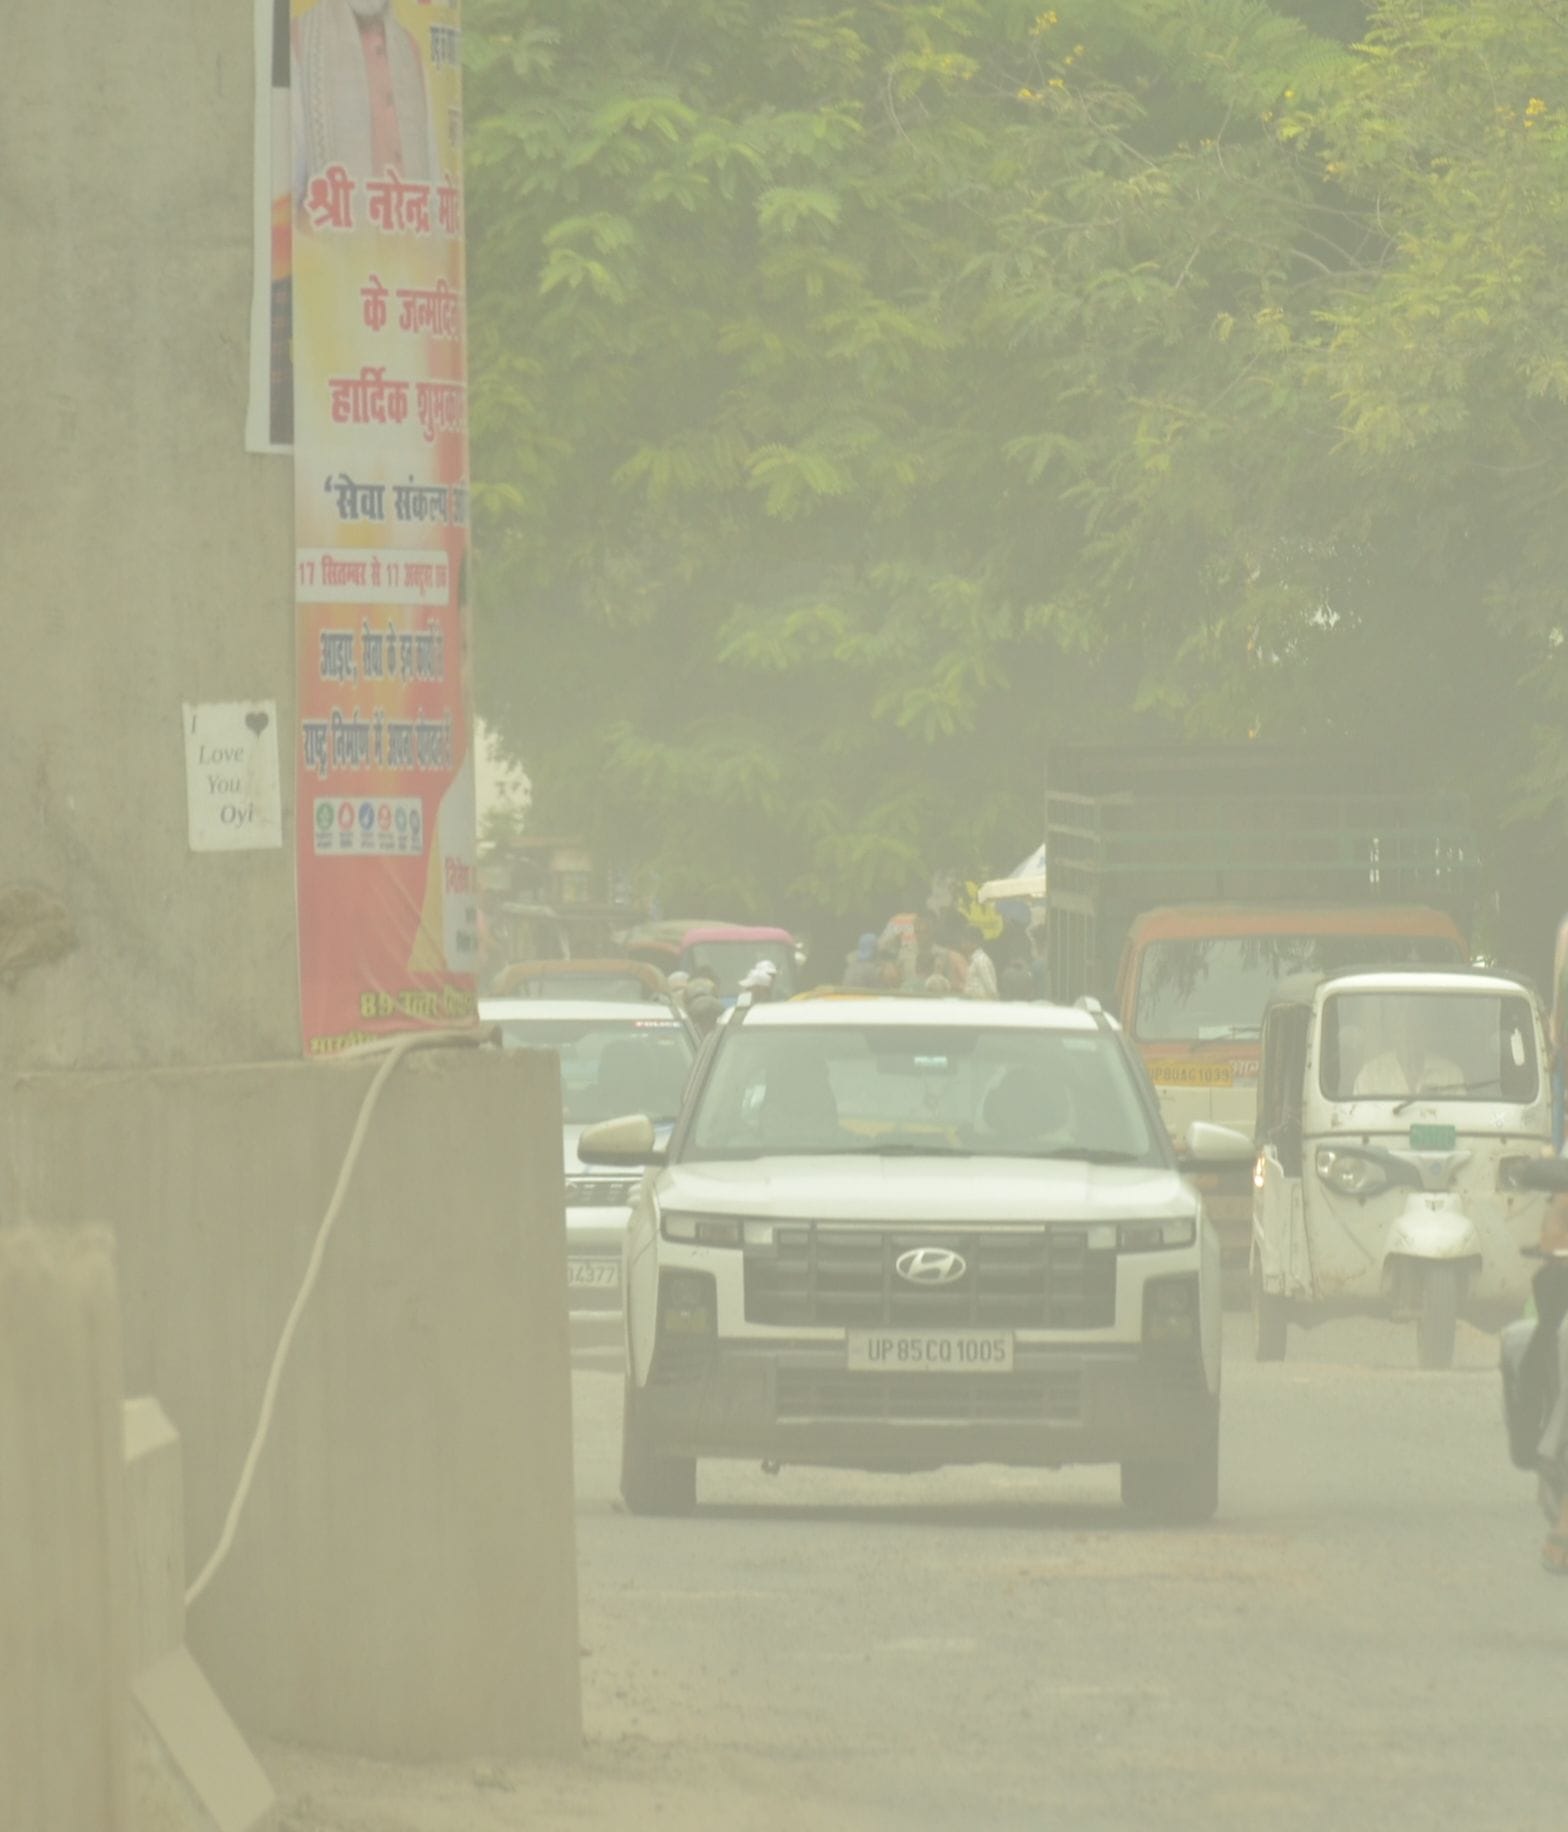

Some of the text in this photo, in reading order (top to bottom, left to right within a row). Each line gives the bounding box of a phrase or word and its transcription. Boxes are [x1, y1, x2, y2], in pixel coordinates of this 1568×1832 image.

[308, 166, 355, 228] श्री
[366, 169, 430, 234] नरेन्द्र
[361, 275, 459, 335] के जन्मदि
[329, 367, 464, 442] हार्दिक शुभका
[392, 474, 448, 522] संकल्प
[299, 562, 314, 585] 17
[387, 563, 399, 586] 11
[199, 745, 244, 766] Love
[207, 774, 240, 795] You
